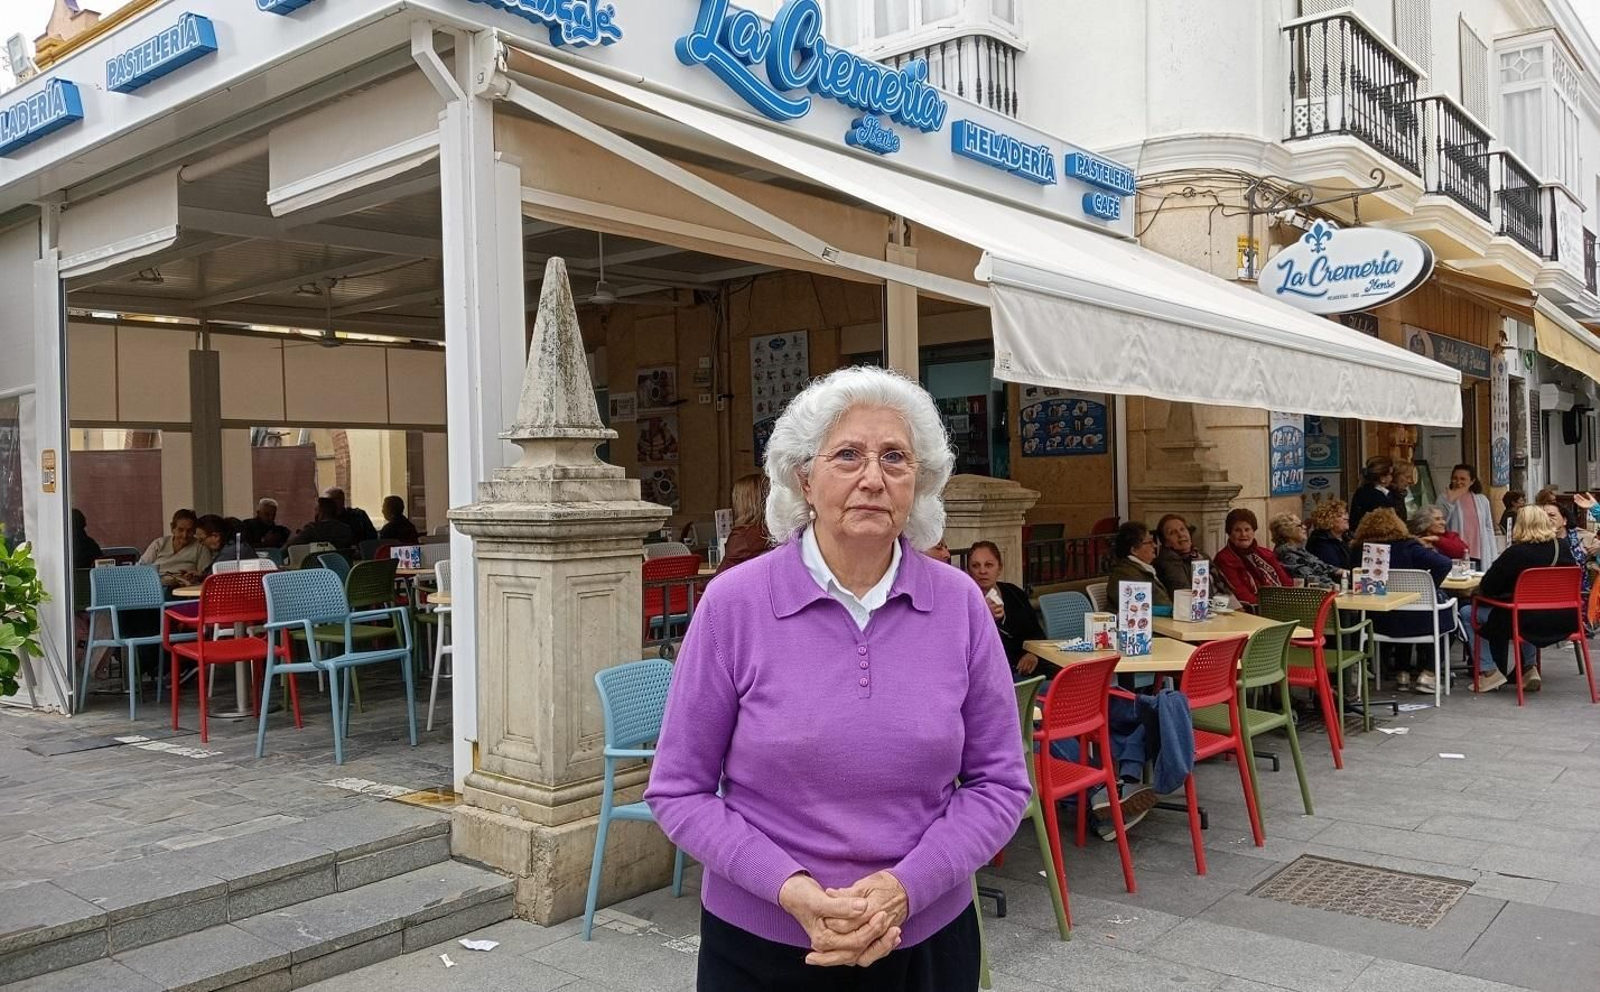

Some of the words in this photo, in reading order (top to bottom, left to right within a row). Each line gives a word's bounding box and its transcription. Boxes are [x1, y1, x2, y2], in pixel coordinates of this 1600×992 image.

[106, 12, 202, 91] PASTELERÍA
[686, 0, 812, 119] La
[0, 77, 67, 148] LADERÍA
[964, 120, 1057, 185] HELADERÍA
[1075, 152, 1136, 195] PASTELERÍA
[1094, 192, 1120, 219] CAFÉ
[1275, 258, 1328, 298] La
[1308, 249, 1403, 288] Cremería
